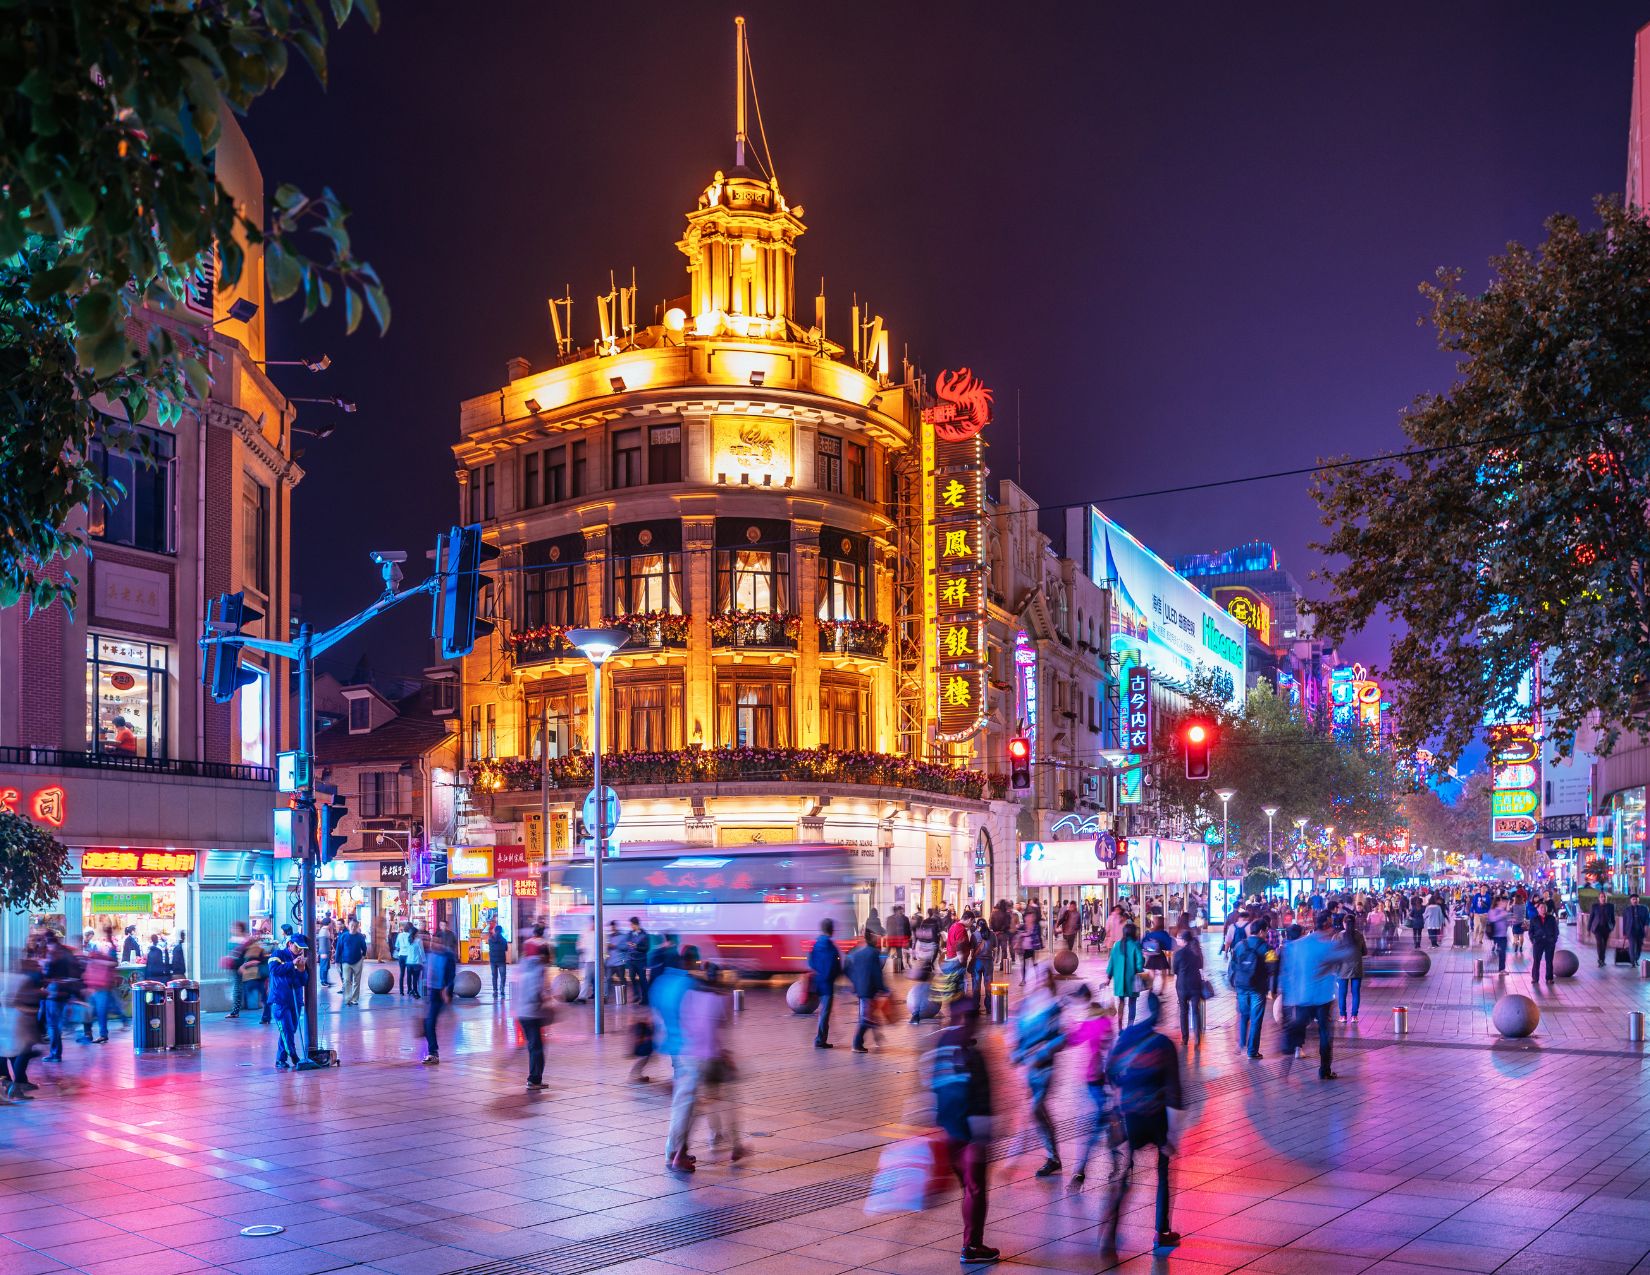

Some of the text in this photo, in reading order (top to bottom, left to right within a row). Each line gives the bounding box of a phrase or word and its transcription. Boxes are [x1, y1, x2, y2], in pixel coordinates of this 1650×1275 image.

[942, 479, 974, 707] 老鳳祥銀樓
[1164, 603, 1178, 625] ULED
[1202, 611, 1243, 669] Hisense
[1130, 675, 1148, 746] 古今内衣
